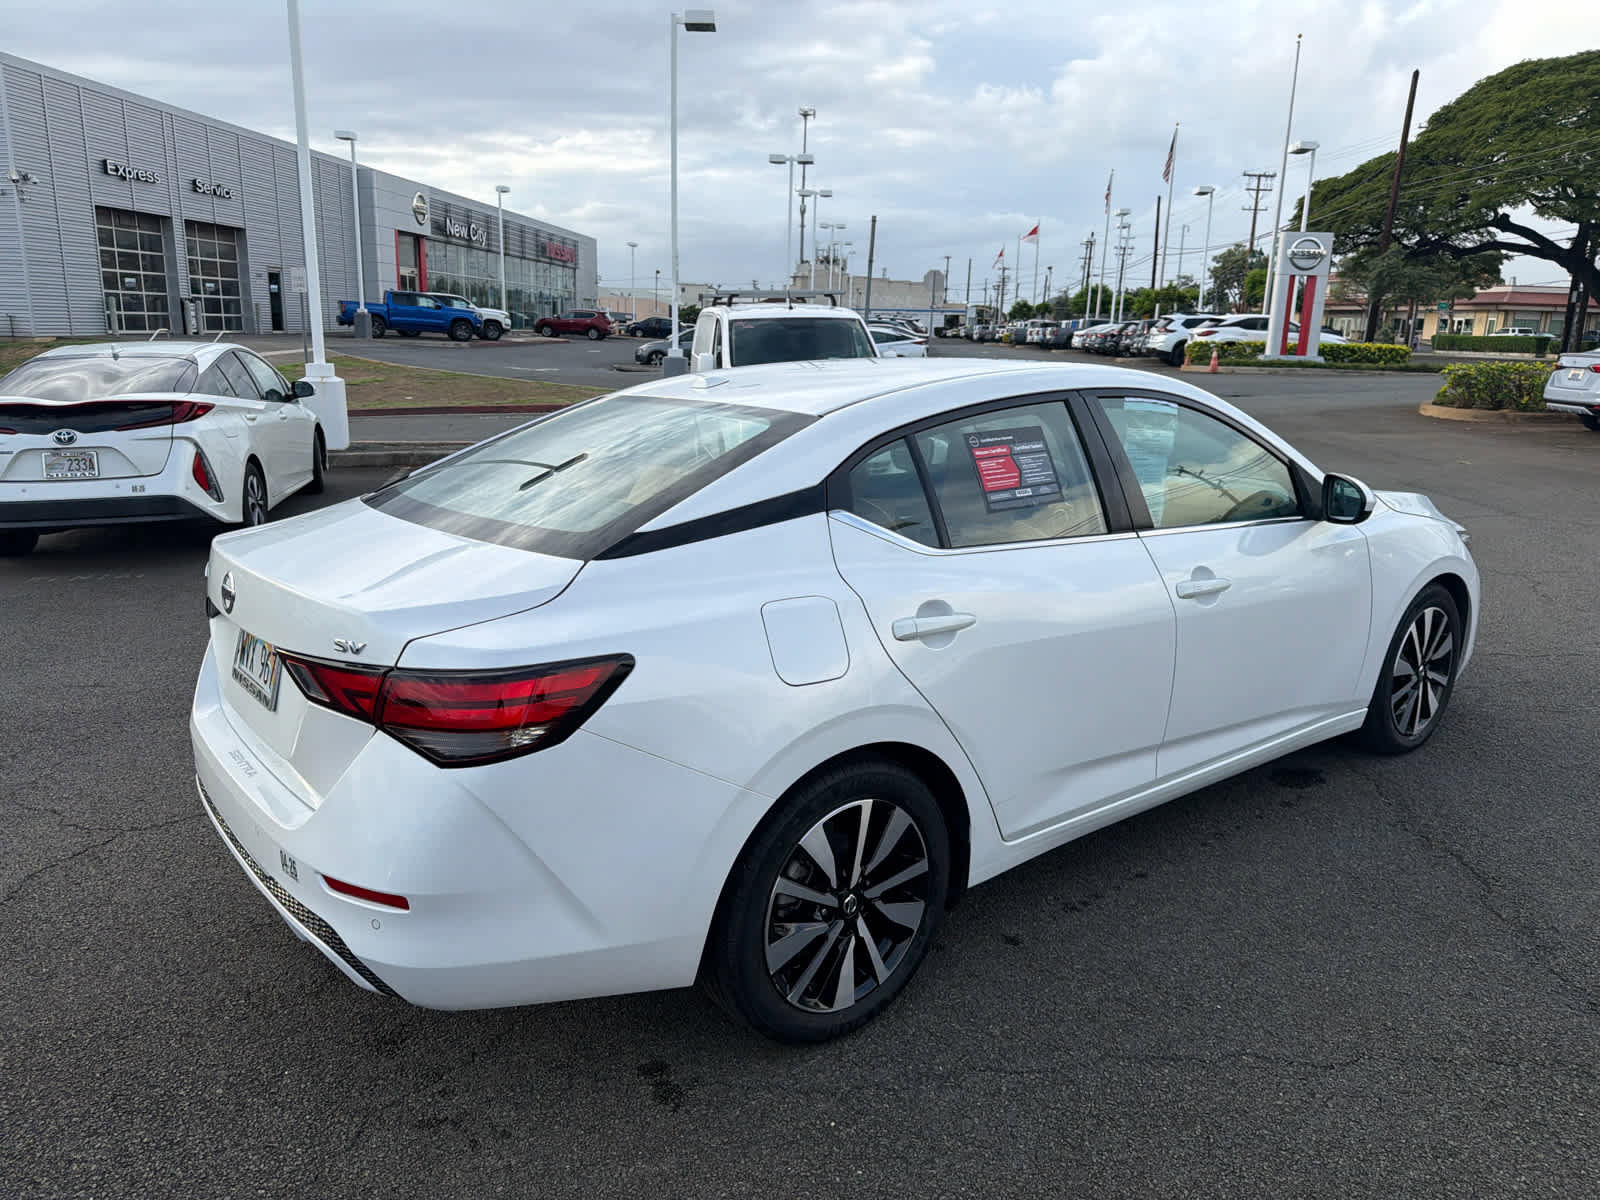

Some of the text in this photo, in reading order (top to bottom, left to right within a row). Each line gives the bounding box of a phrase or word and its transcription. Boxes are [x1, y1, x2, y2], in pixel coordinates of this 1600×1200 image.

[104, 159, 161, 184] Express
[194, 179, 238, 199] Service
[446, 217, 487, 247] New City
[332, 638, 368, 656] SV
[232, 667, 274, 711] NISSAN
